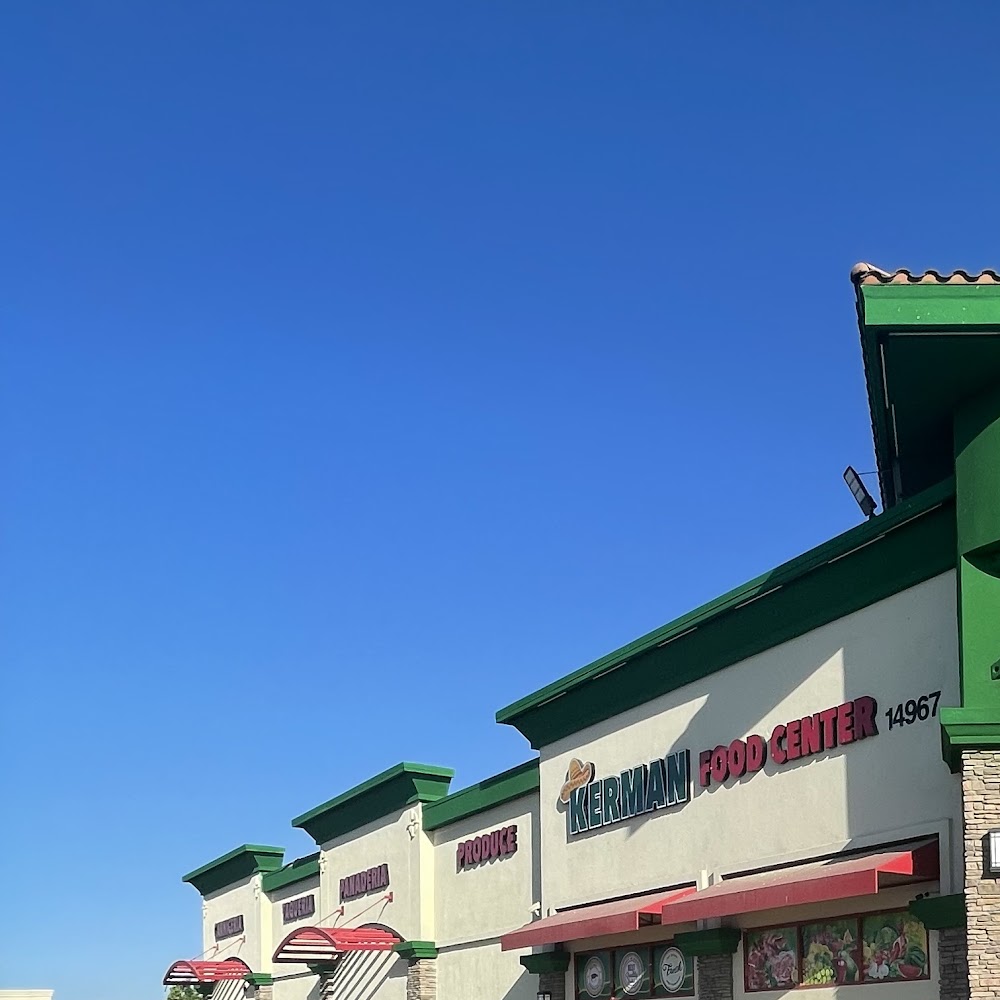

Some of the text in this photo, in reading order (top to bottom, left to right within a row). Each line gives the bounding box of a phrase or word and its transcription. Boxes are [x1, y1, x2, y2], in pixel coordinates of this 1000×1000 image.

[885, 691, 941, 730] 14967
[568, 695, 879, 835] KERMAN FOOD CENTER
[457, 825, 518, 867] PRODUCE
[340, 863, 389, 899] PANADERIA
